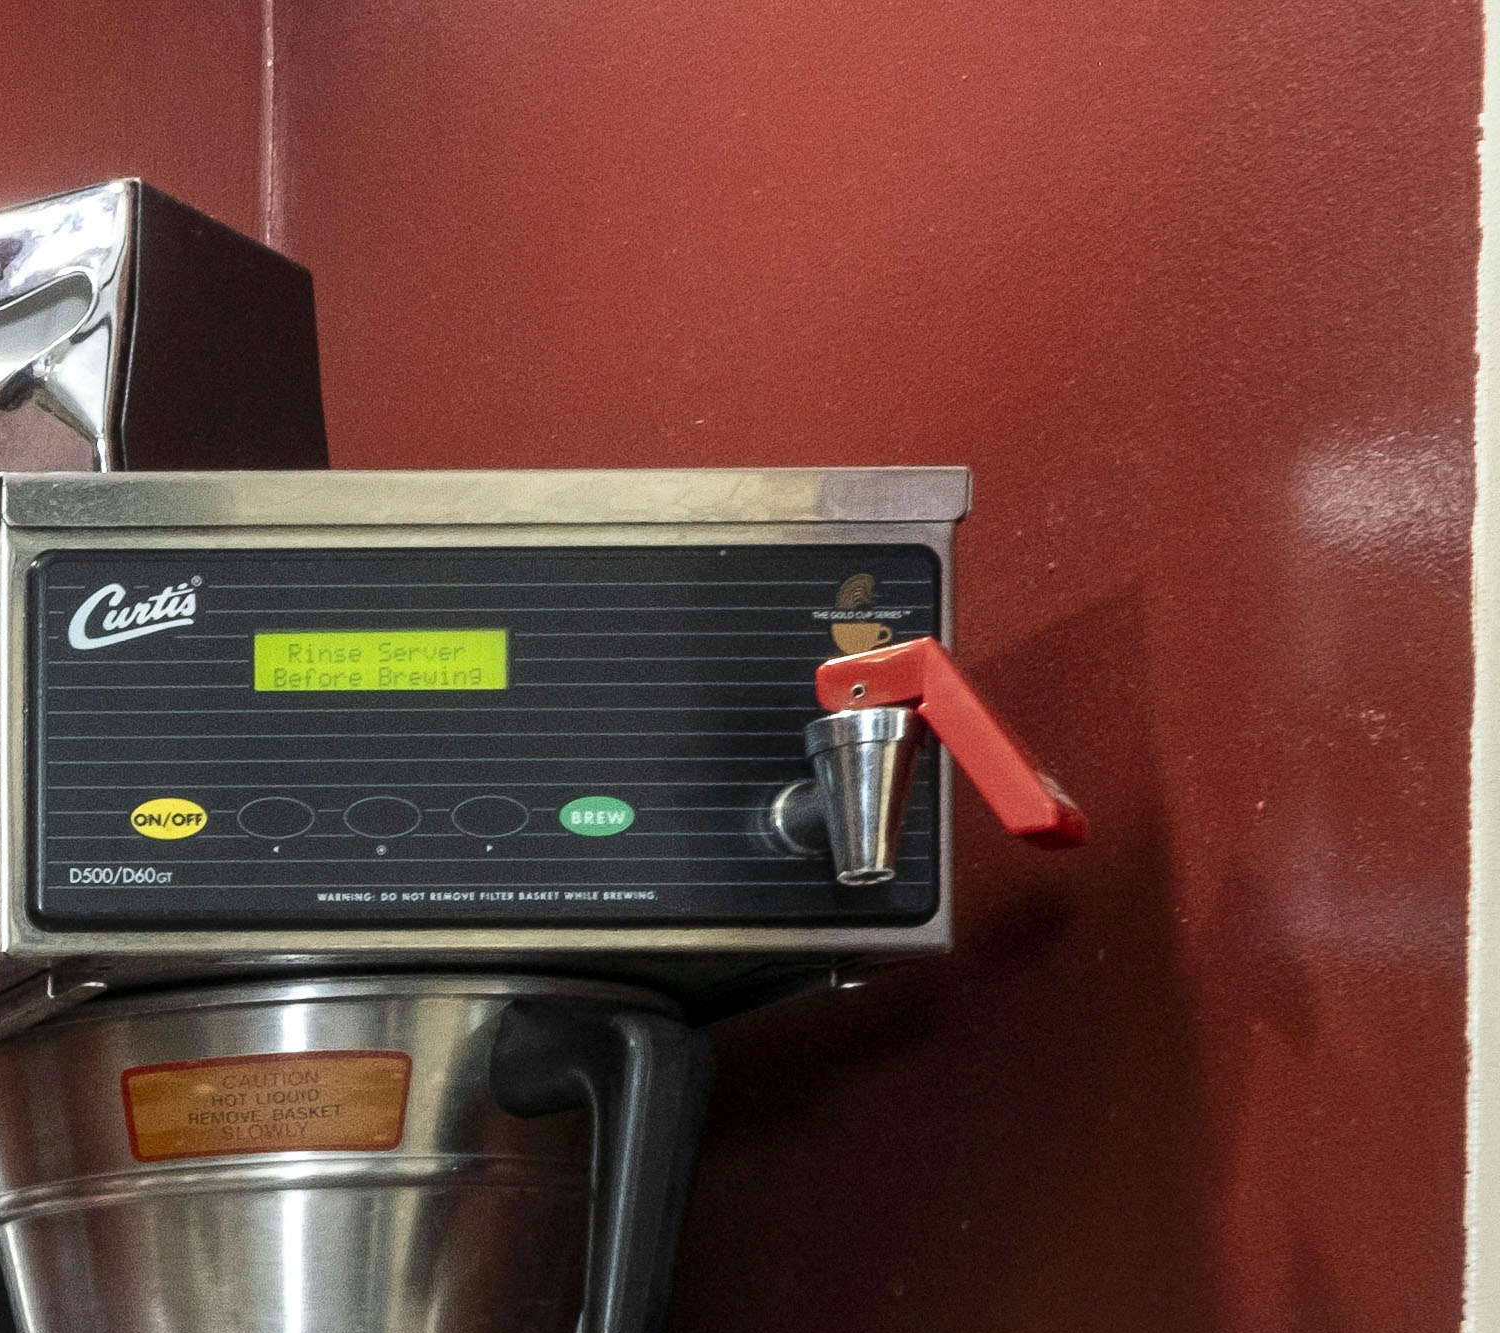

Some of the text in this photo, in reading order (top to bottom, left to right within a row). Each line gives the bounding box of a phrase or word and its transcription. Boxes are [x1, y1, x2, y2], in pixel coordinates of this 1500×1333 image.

[68, 583, 197, 650] Curtis
[830, 611, 854, 619] GOLD
[288, 642, 465, 664] Rinse Server
[273, 667, 482, 689] Before Brewing
[133, 811, 204, 829] ON/OFF
[570, 810, 626, 826] BREW
[69, 867, 173, 885] D500/D60GT
[381, 892, 395, 902] DO
[402, 892, 425, 902] NOT
[430, 892, 475, 901] REMOVE
[480, 892, 513, 901] FILTER
[518, 891, 558, 901] BASKET
[564, 891, 598, 901] WHILE
[222, 1071, 320, 1089] CAUTION
[211, 1089, 320, 1107] HOT LIQUID
[188, 1104, 341, 1125] REMOVE BASKET
[222, 1123, 307, 1139] SLOWLY
